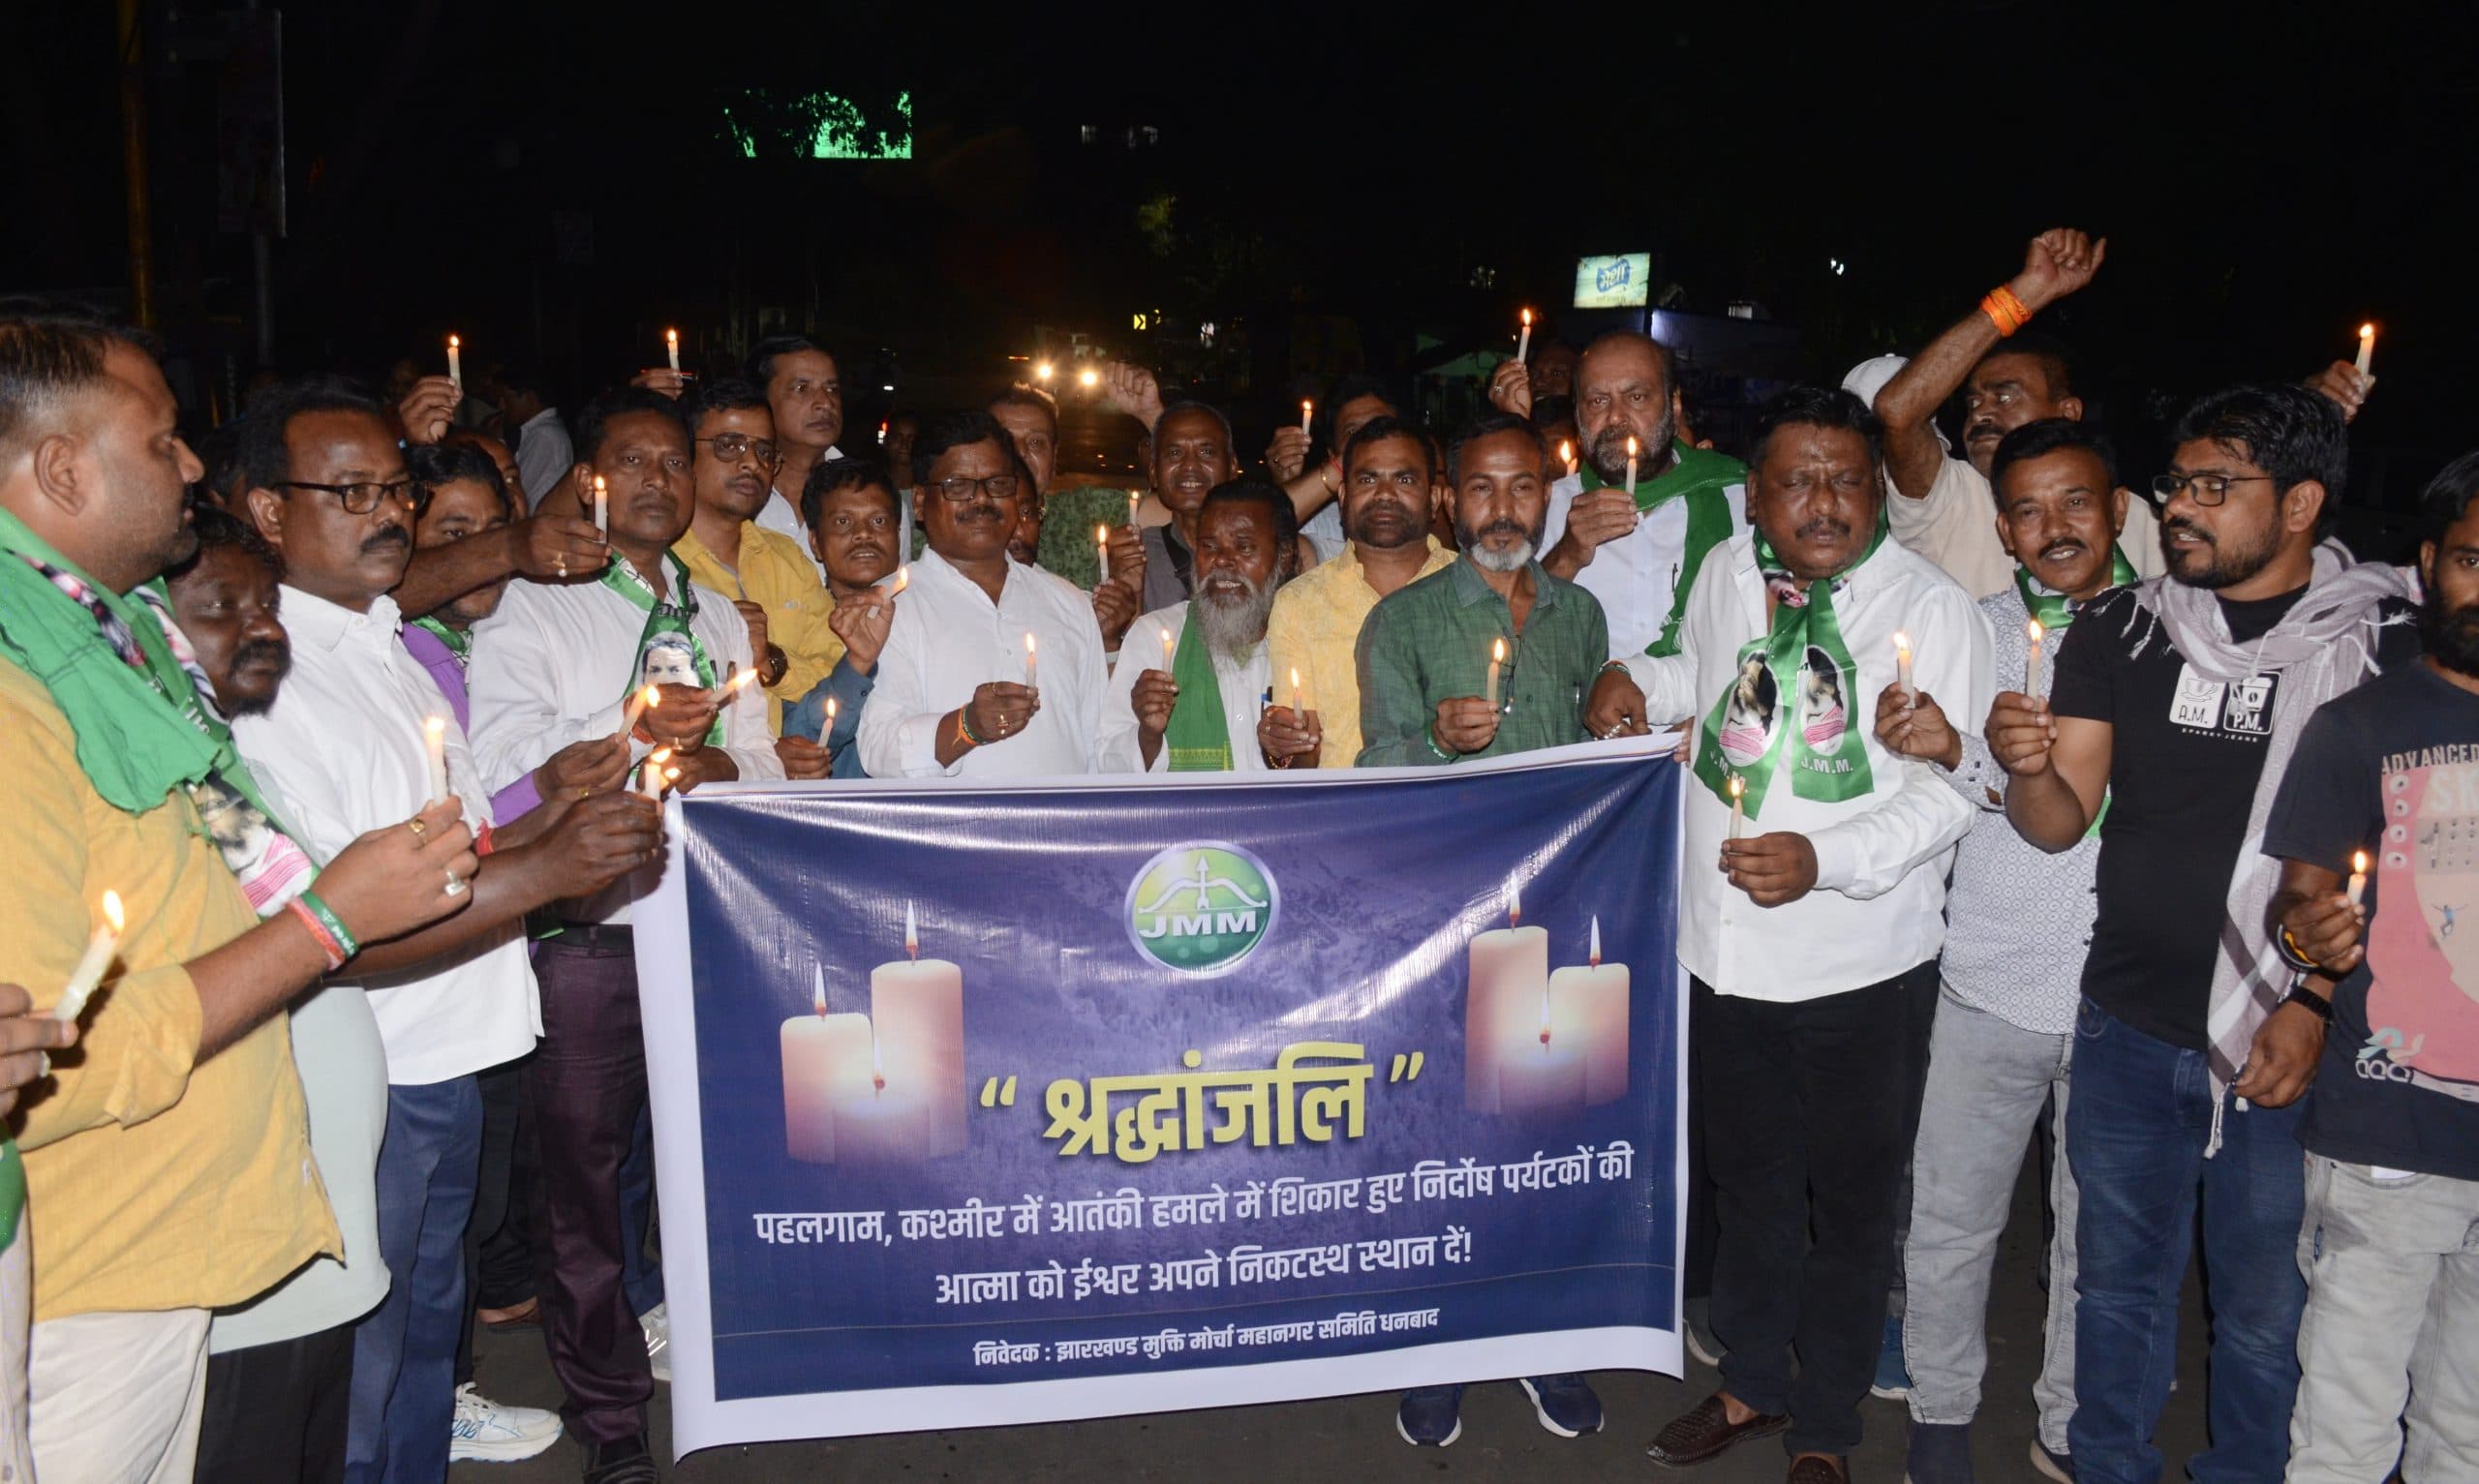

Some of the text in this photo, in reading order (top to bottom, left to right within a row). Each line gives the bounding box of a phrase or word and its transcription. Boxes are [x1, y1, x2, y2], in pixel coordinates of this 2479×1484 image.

[2178, 705, 2208, 724] A.M.
[2233, 712, 2263, 731] P.M.
[1801, 756, 1853, 774] J.M.M.
[1138, 910, 1257, 939] JMM
[752, 1140, 1635, 1248] पहलगाम, कश्मीर में आतंकी हमले में शिकार हुए निर्दोष पर्यटकों की
[935, 1225, 1473, 1305] आत्मा को ईश्वर अपने निकटस्थ स्थान दें!
[973, 1340, 1041, 1366] निवेदक
[1056, 1336, 1138, 1362] झारखण्ड
[1142, 1329, 1184, 1359] मुक्ति
[1188, 1322, 1235, 1351] मोर्चा
[1238, 1317, 1314, 1345] महानगर
[1317, 1311, 1376, 1341] समिति
[1379, 1307, 1441, 1334] धनबाद
